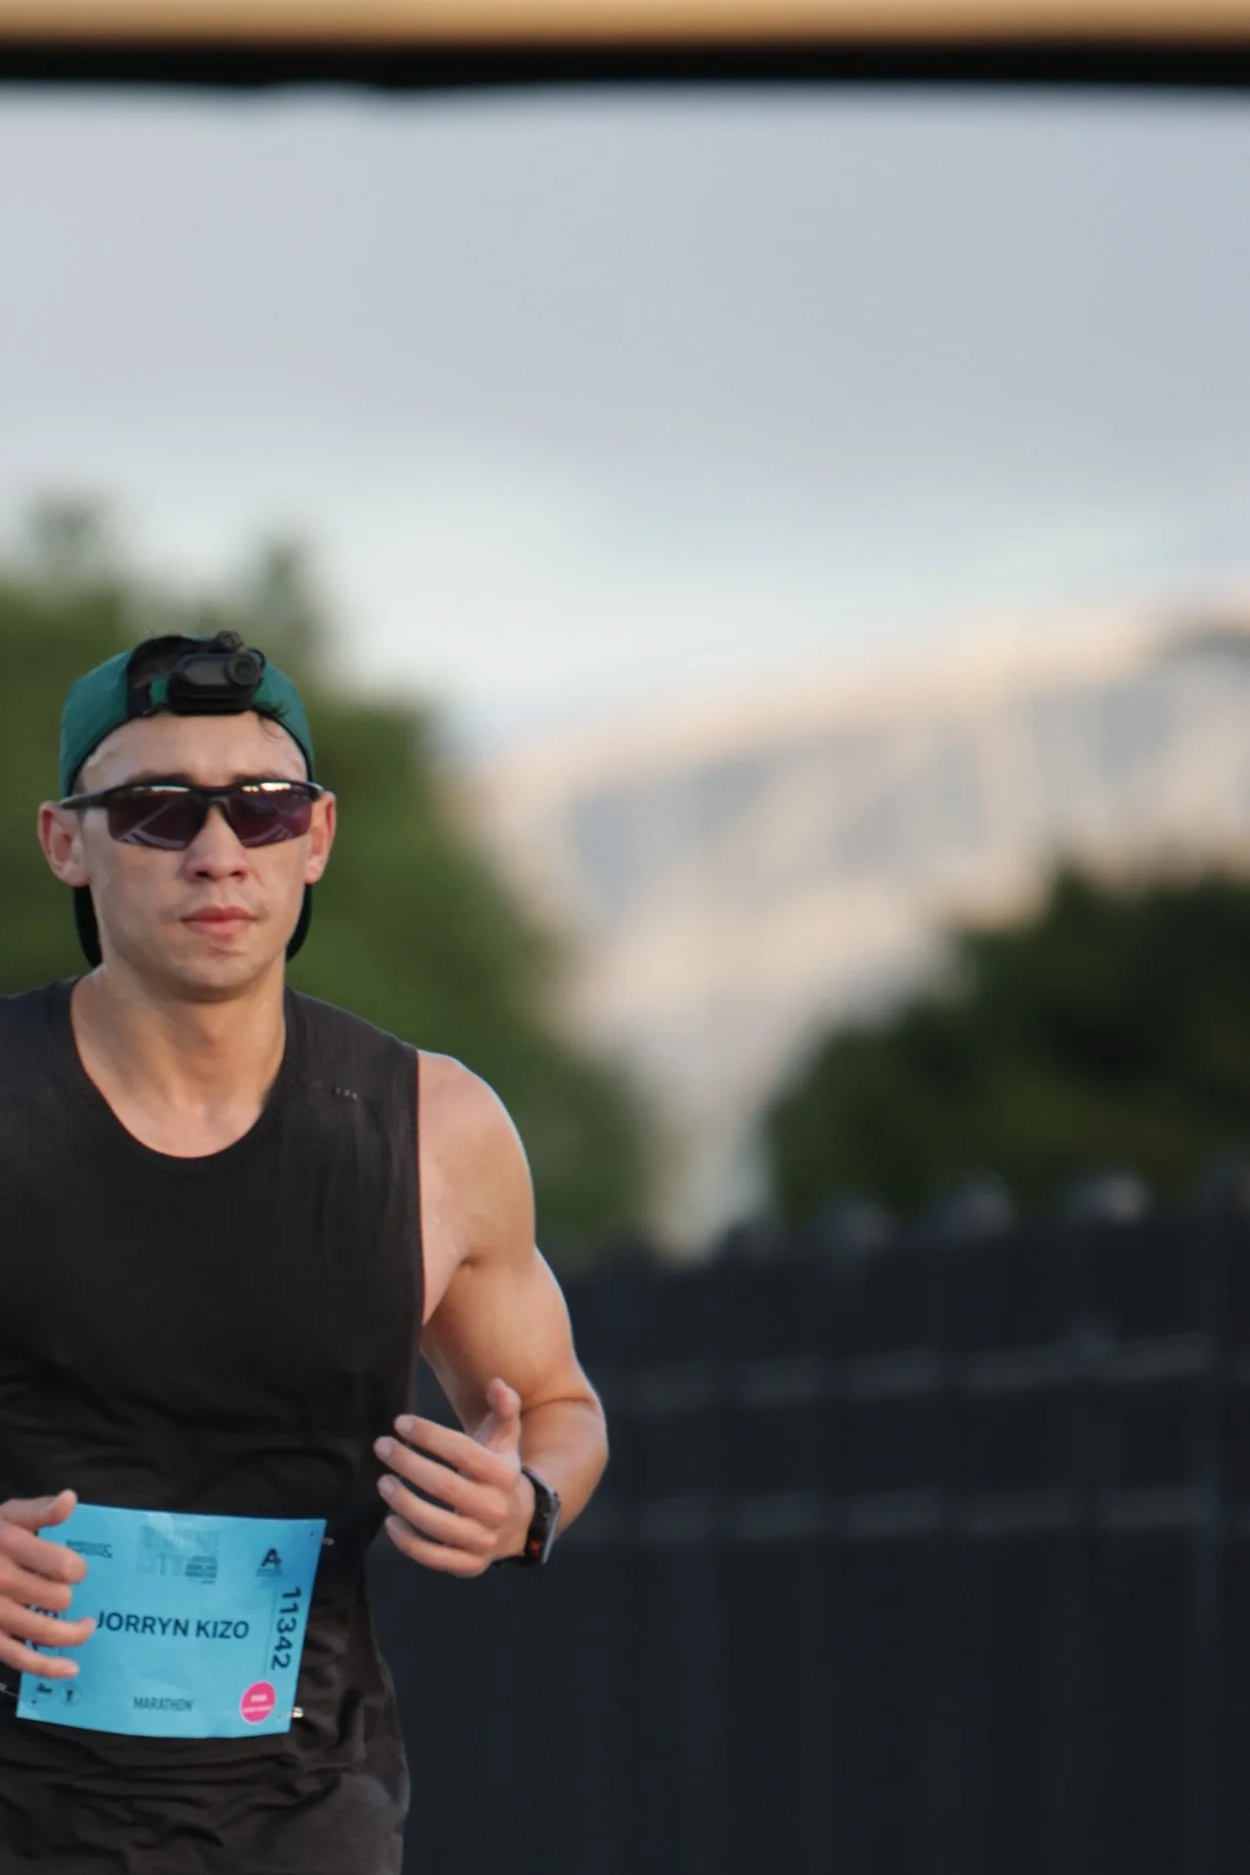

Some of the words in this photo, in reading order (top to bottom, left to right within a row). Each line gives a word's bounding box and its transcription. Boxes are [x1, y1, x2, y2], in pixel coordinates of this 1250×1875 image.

[260, 1548, 283, 1567] A
[95, 1609, 190, 1638] JORRYN
[195, 1618, 250, 1640] KIZO
[271, 1587, 302, 1670] 11342
[133, 1695, 193, 1712] MARATHON
